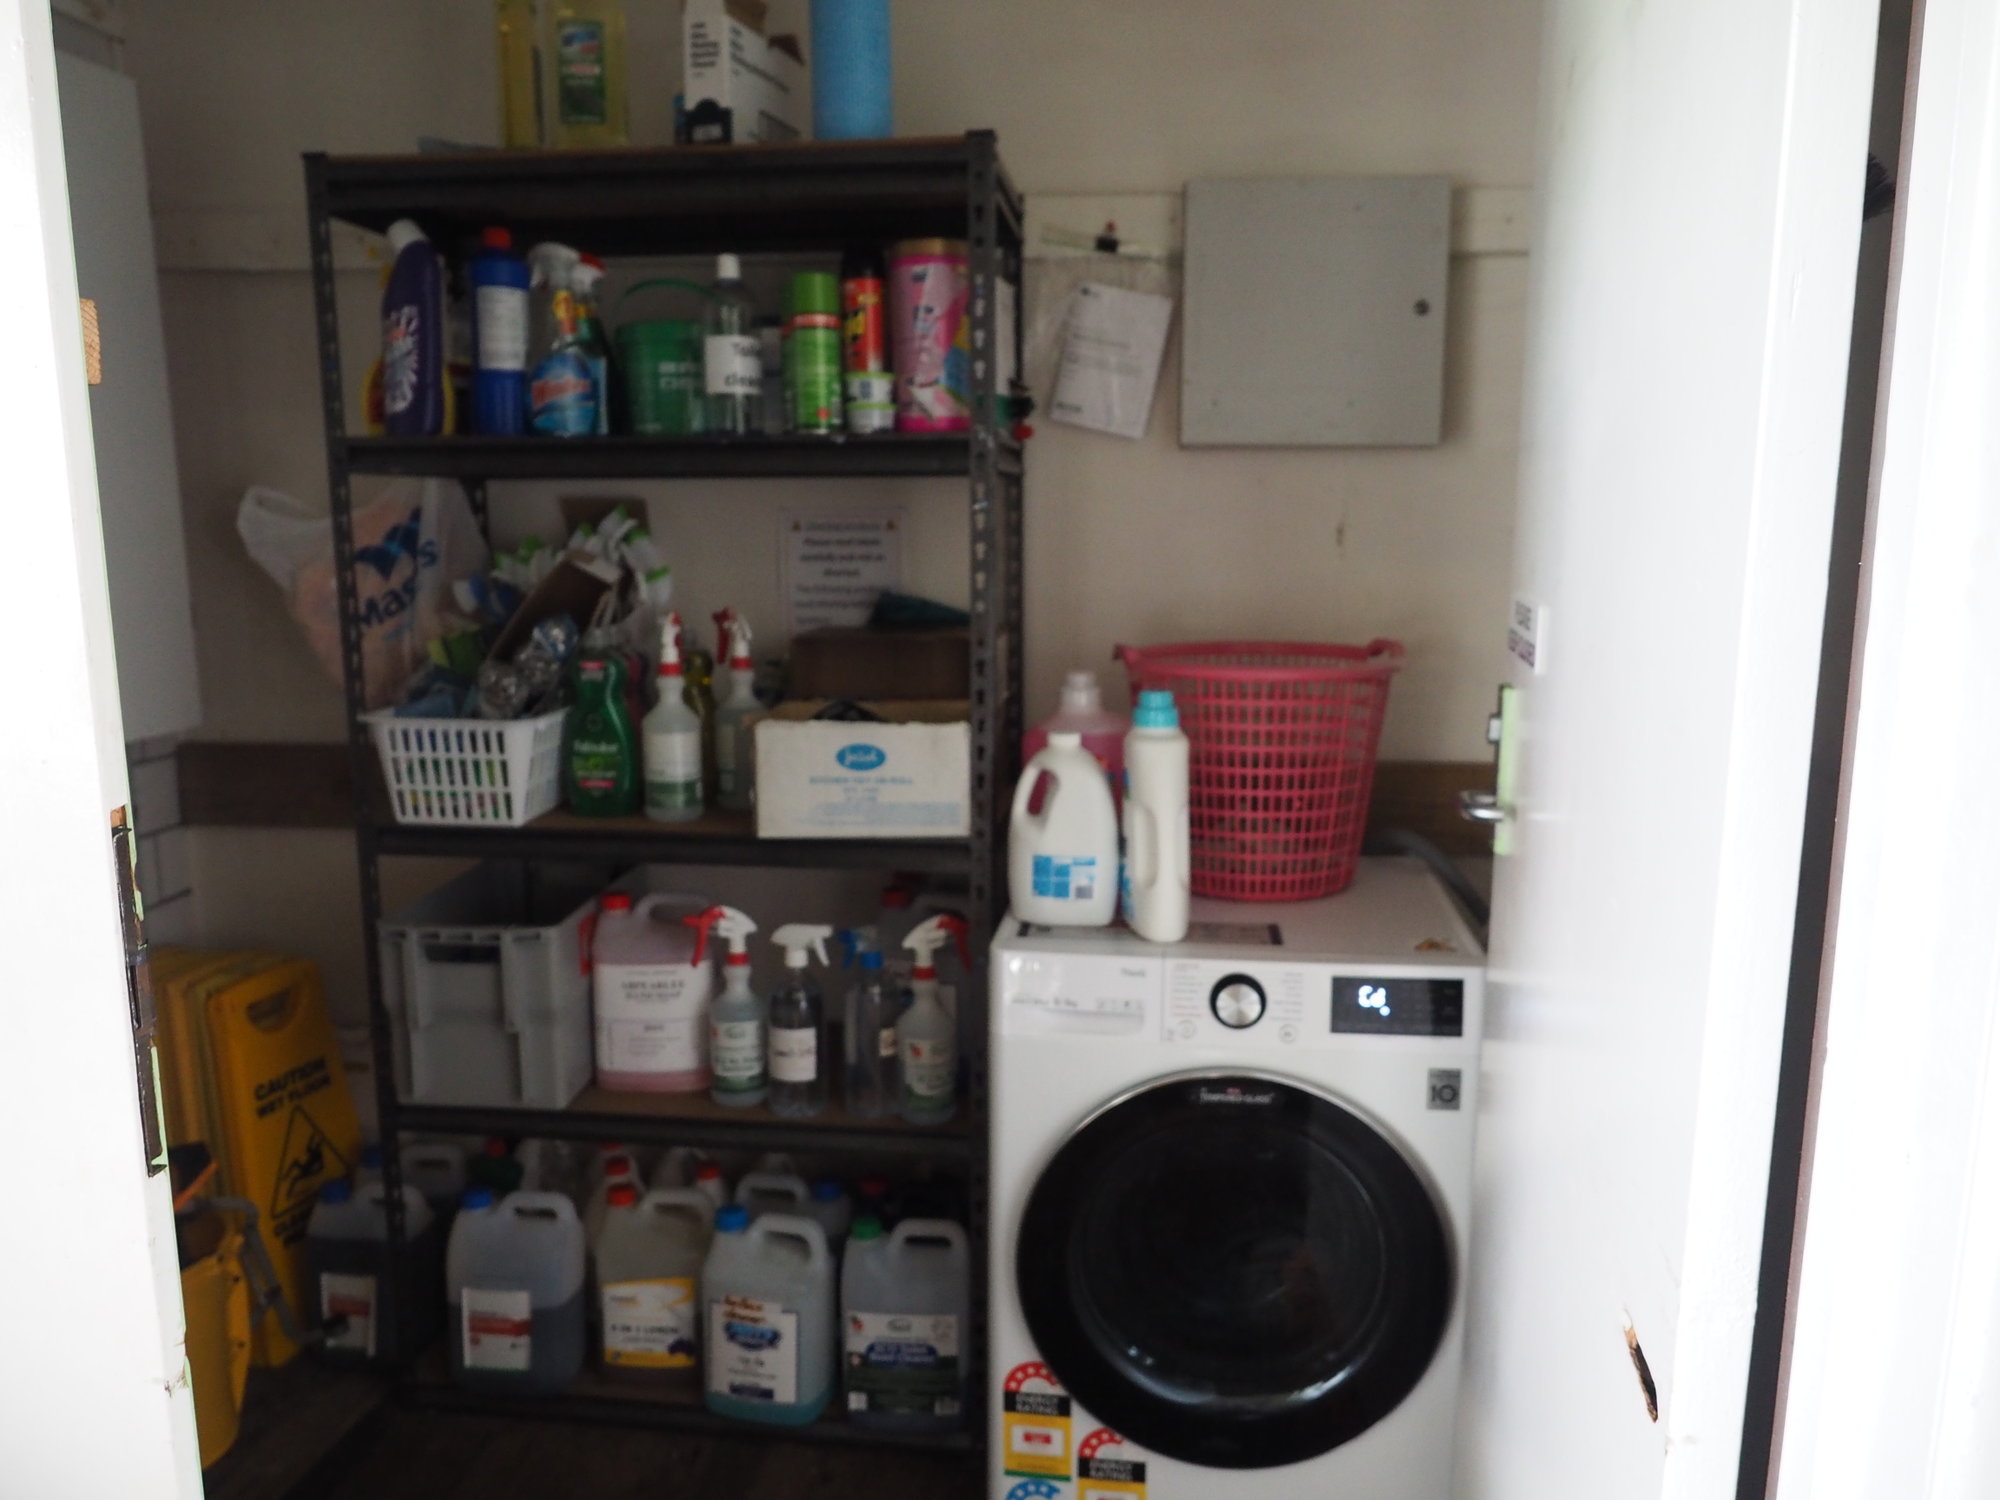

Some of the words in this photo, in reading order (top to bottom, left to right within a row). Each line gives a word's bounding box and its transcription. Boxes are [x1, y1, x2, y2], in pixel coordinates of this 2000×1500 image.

[254, 1056, 327, 1101] CAUTION
[256, 1096, 284, 1119] WET
[287, 1073, 332, 1104] FLOOR
